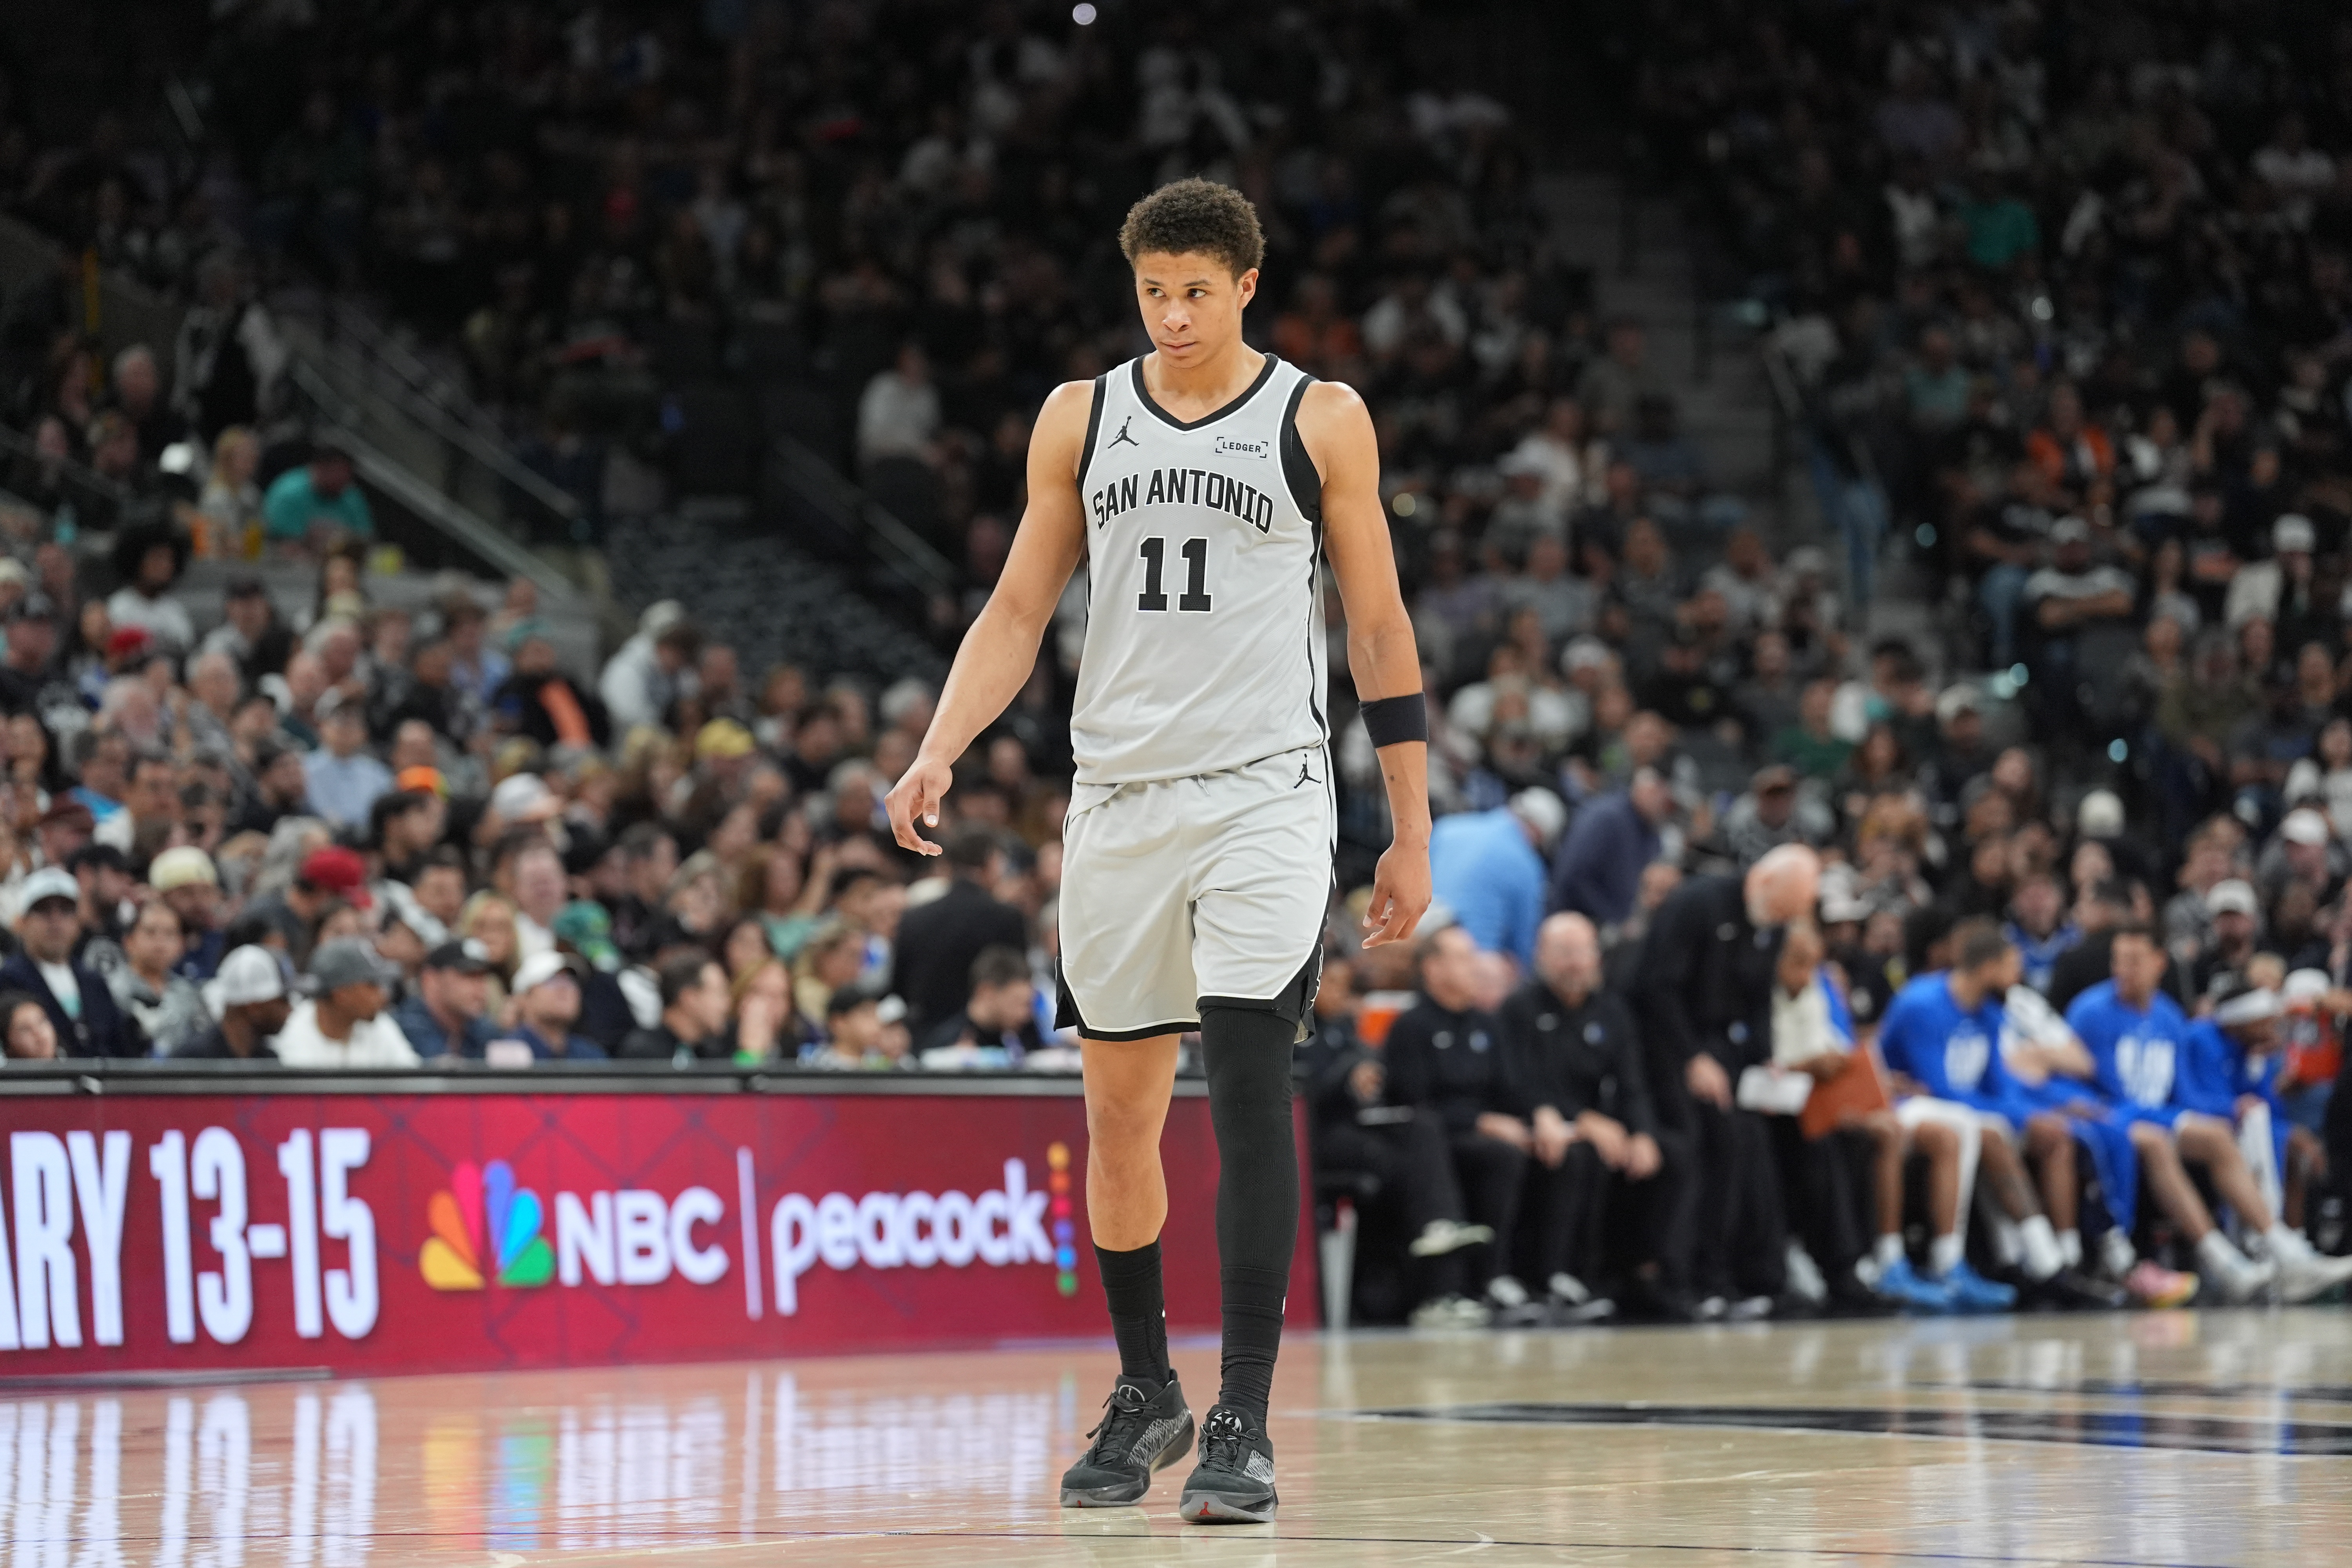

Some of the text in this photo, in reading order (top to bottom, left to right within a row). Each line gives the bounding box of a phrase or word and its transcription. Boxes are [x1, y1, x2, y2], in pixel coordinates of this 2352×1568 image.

[1223, 441, 1261, 452] LEDGER
[1093, 467, 1274, 536] SAN ANTONIO
[1136, 535, 1213, 614] 11
[149, 1126, 379, 1344] 13-15
[554, 1156, 1055, 1316] NBC peacock
